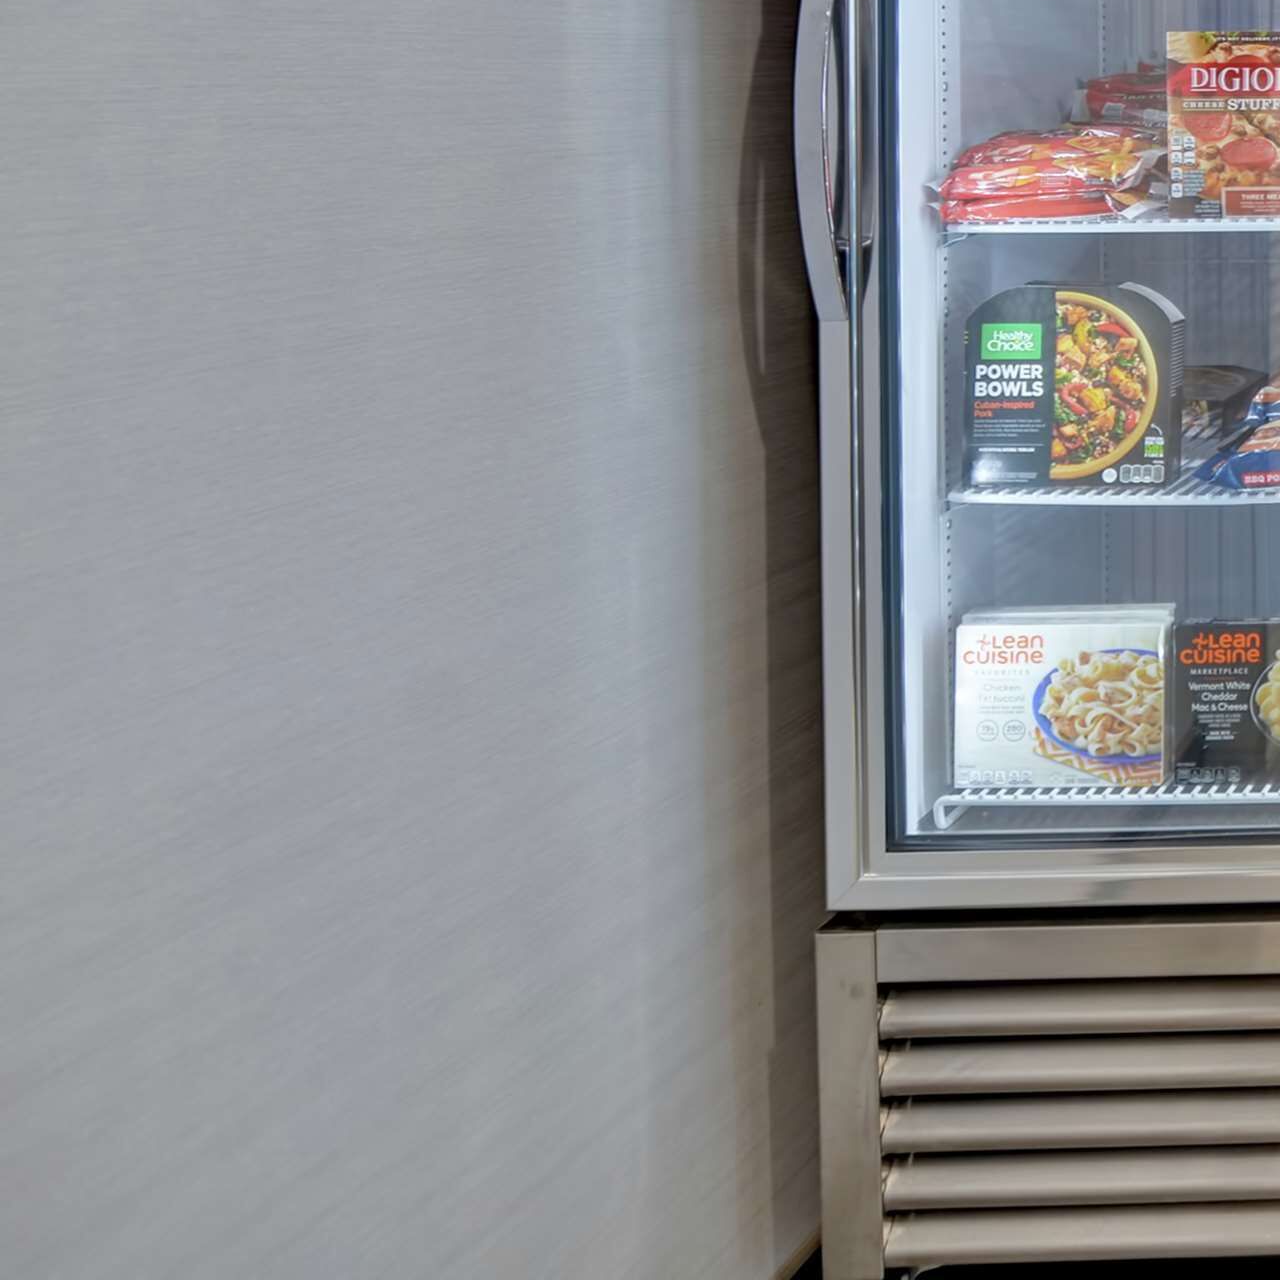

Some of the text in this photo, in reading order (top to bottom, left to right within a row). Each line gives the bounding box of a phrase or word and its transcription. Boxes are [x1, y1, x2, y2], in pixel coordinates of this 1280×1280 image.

[1184, 100, 1225, 109] CHEESE
[992, 330, 1034, 342] Healthy
[986, 338, 1035, 352] Choice
[975, 364, 1044, 380] POWER
[974, 381, 1044, 398] BOWLS
[974, 409, 993, 418] Pork
[1188, 681, 1251, 691] Vermont White
[1201, 691, 1238, 702] Cheddar
[1191, 702, 1249, 712] Mac Cheese
